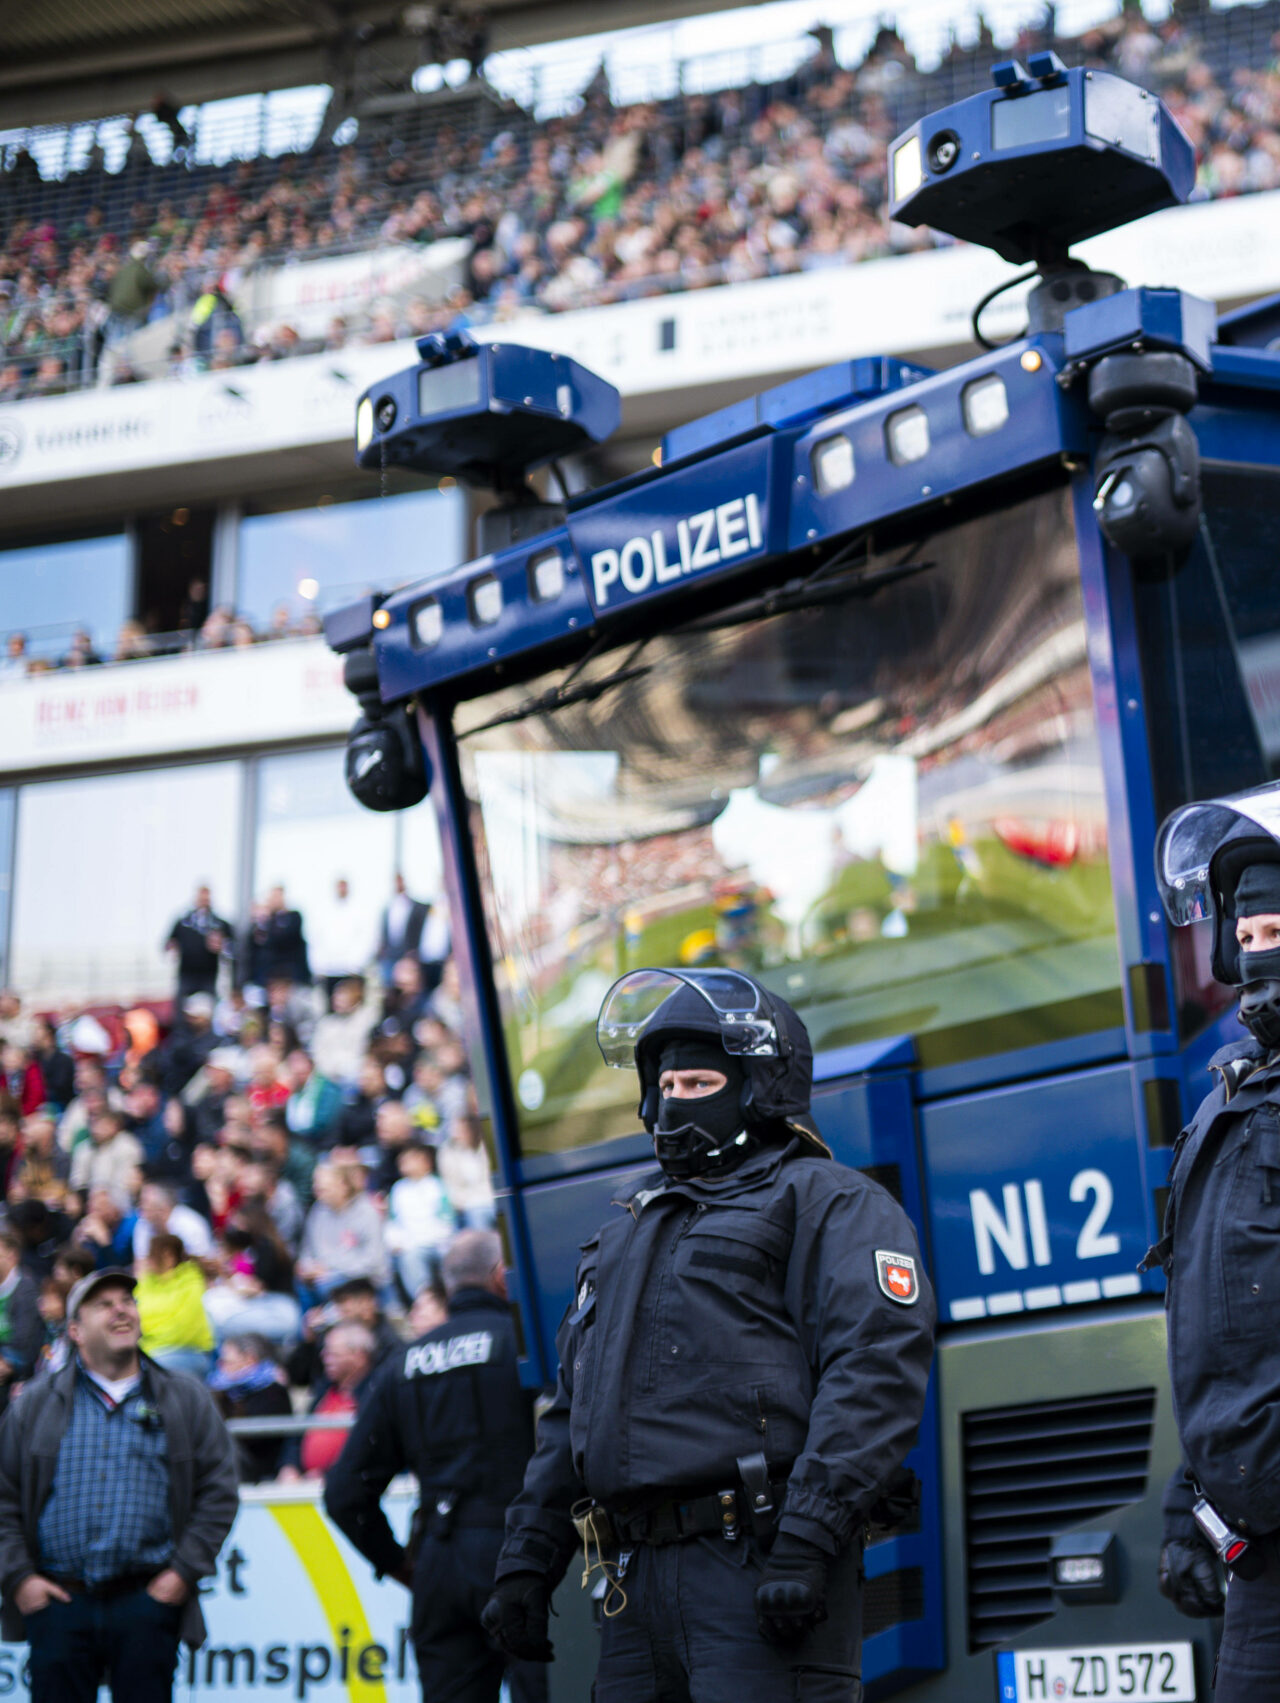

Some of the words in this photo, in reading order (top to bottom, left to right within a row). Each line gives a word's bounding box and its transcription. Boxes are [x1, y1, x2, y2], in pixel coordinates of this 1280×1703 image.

[591, 492, 763, 606] POLIZEI
[969, 1178, 1051, 1275] NI
[1069, 1168, 1121, 1259] 2
[404, 1331, 493, 1380] POLIZEI
[1026, 1659, 1047, 1699] H
[1070, 1656, 1108, 1697] ZD
[1117, 1652, 1177, 1695] 572
